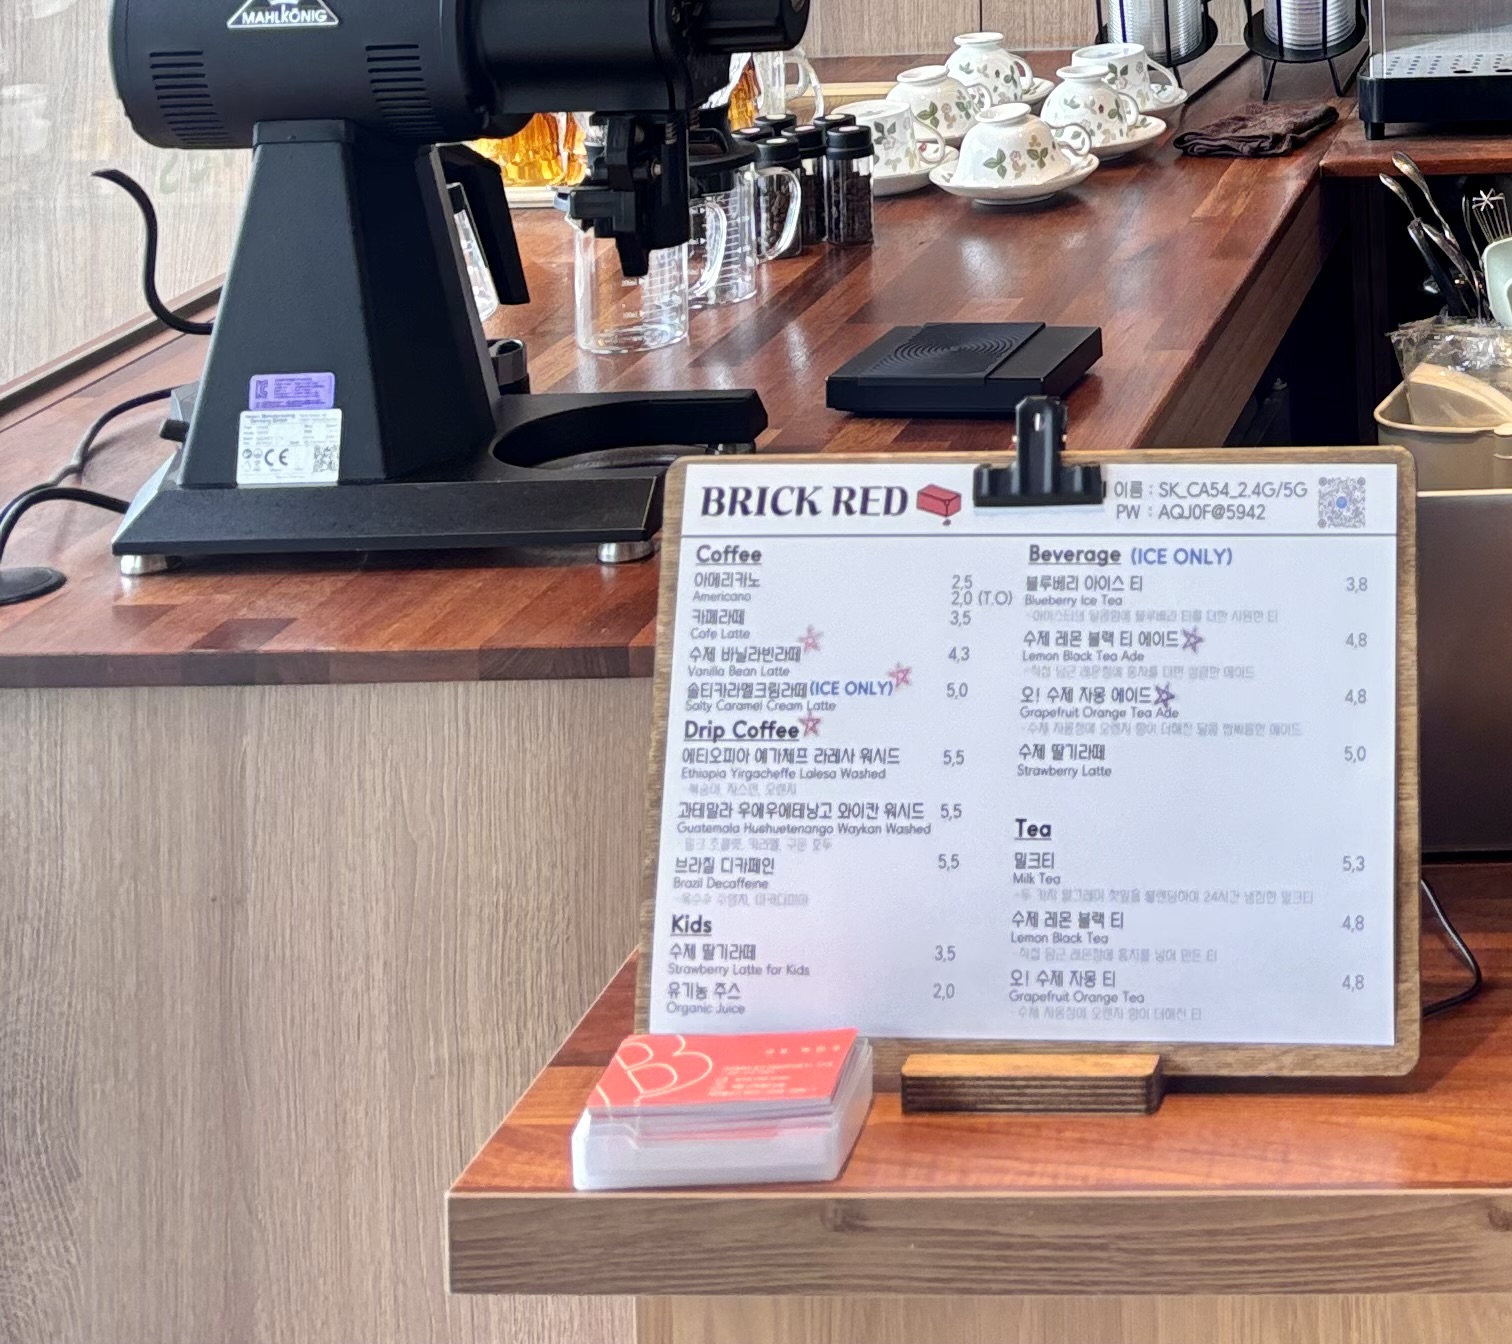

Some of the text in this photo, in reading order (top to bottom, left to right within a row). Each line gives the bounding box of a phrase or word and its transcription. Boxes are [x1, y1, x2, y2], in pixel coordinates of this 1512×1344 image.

[1114, 481, 1143, 499] 이름
[701, 486, 908, 516] BRICK RED
[1116, 504, 1140, 520] PW
[696, 545, 762, 562] Coffee
[1029, 544, 1232, 567] Beverage (ICE ONLY)
[1026, 575, 1143, 592] 블루베리 아이스 티
[693, 591, 751, 602] Americano
[1025, 594, 1122, 608] Blueberry Ice Tea
[690, 627, 750, 640] Cafe Latte
[1024, 630, 1179, 648] 수제 레몬 블랙 티 에이드
[690, 646, 716, 663] 수제
[1022, 650, 1144, 662] Lemon Black Tea Ade
[688, 665, 790, 677] Vanilla Bean Latte
[1047, 687, 1073, 703] 수제
[1079, 687, 1105, 704] 자몽
[1111, 687, 1151, 704] 에이드
[685, 699, 837, 714] Salty Caramel Cream Latte
[1020, 705, 1179, 720] Grapefruit Orange Tea Ade
[685, 720, 800, 742] Drip Coffee
[859, 748, 900, 765] 워시드
[1019, 744, 1105, 761] 수제 딸기라떼
[681, 767, 726, 781] Ethiopia
[731, 767, 796, 781] Yirgacheffe
[840, 768, 886, 780] Washed
[1017, 764, 1112, 779] Strawberry Latte
[884, 802, 924, 820] 워시드
[677, 822, 740, 834] Guatemala
[838, 823, 882, 836] Waykan
[886, 823, 931, 835] Washed
[1015, 818, 1051, 838] Tea
[675, 857, 774, 875] 브라질 디카페인
[1014, 852, 1054, 869] 밀크티
[673, 876, 769, 890] Brazil Decaffeine
[1013, 872, 1061, 885] Milk Tea
[672, 914, 712, 933] Kids
[1012, 911, 1123, 929] 수제 레몬 블랙 티
[1011, 931, 1108, 944] Lemon Black Tea
[670, 943, 756, 961] 수제 딸기라떼
[668, 962, 810, 977] Strawberry Latte for Kids
[1036, 970, 1063, 987] 수제
[1069, 970, 1096, 988] 자몽
[1103, 971, 1115, 987] 티
[668, 982, 741, 1001] 유기농 주스
[1008, 990, 1144, 1006] Grapefruit Orange Tea
[666, 1002, 746, 1016] Organic Juice
